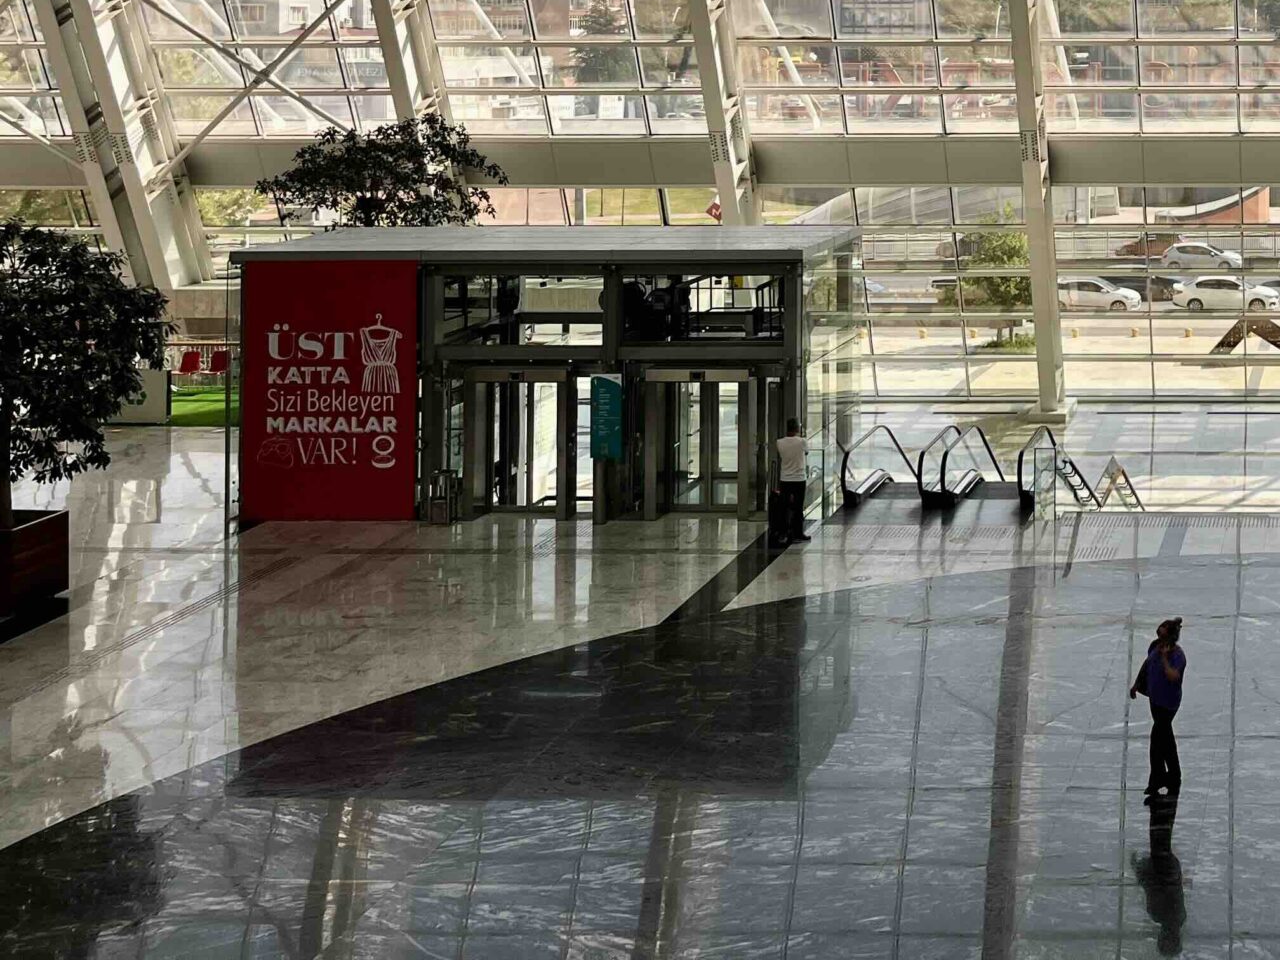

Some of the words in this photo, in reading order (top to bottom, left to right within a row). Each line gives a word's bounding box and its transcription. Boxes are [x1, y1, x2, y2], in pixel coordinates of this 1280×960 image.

[266, 323, 354, 360] ÜST
[267, 366, 350, 385] KATTA
[266, 389, 301, 412] Sizi
[307, 389, 394, 419] Bekleyen
[266, 416, 398, 434] MARKALAR
[297, 437, 357, 465] VAR!
